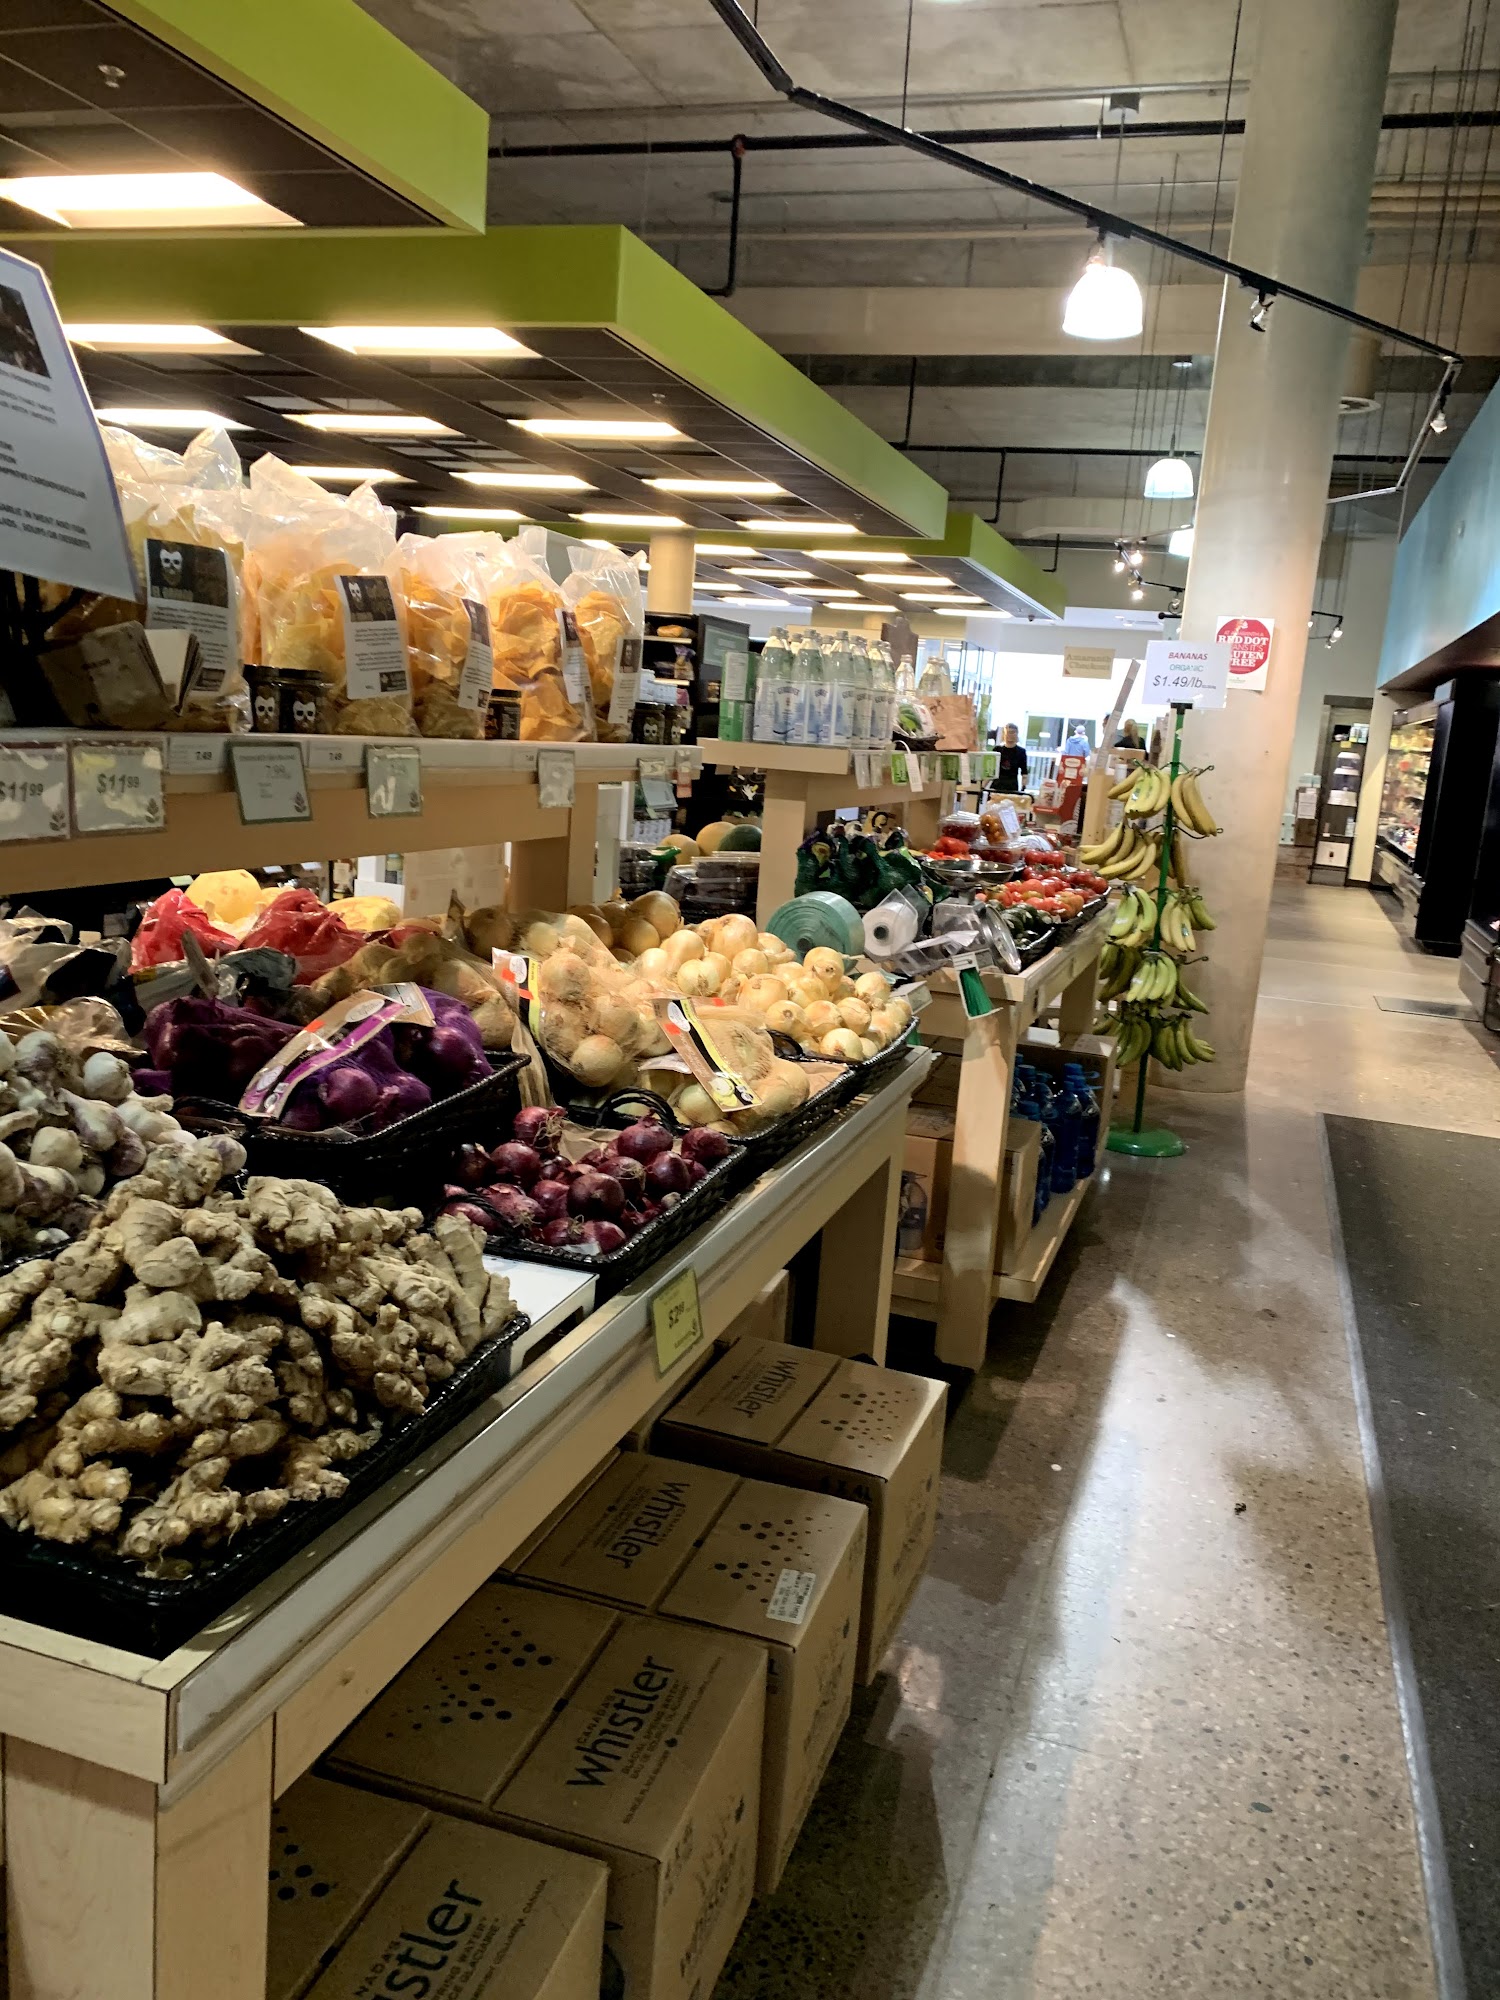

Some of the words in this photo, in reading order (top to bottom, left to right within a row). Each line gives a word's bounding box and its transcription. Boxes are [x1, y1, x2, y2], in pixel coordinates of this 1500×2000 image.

[1218, 635, 1244, 644] RED
[1243, 635, 1269, 646] DOT
[1168, 652, 1208, 660] BANANAS
[1233, 650, 1264, 660] UTEN
[1169, 663, 1204, 672] ORGANIC
[1231, 658, 1256, 668] REE
[732, 1360, 800, 1419] whistler
[605, 1482, 691, 1569] whistler
[565, 1655, 675, 1786] whistler
